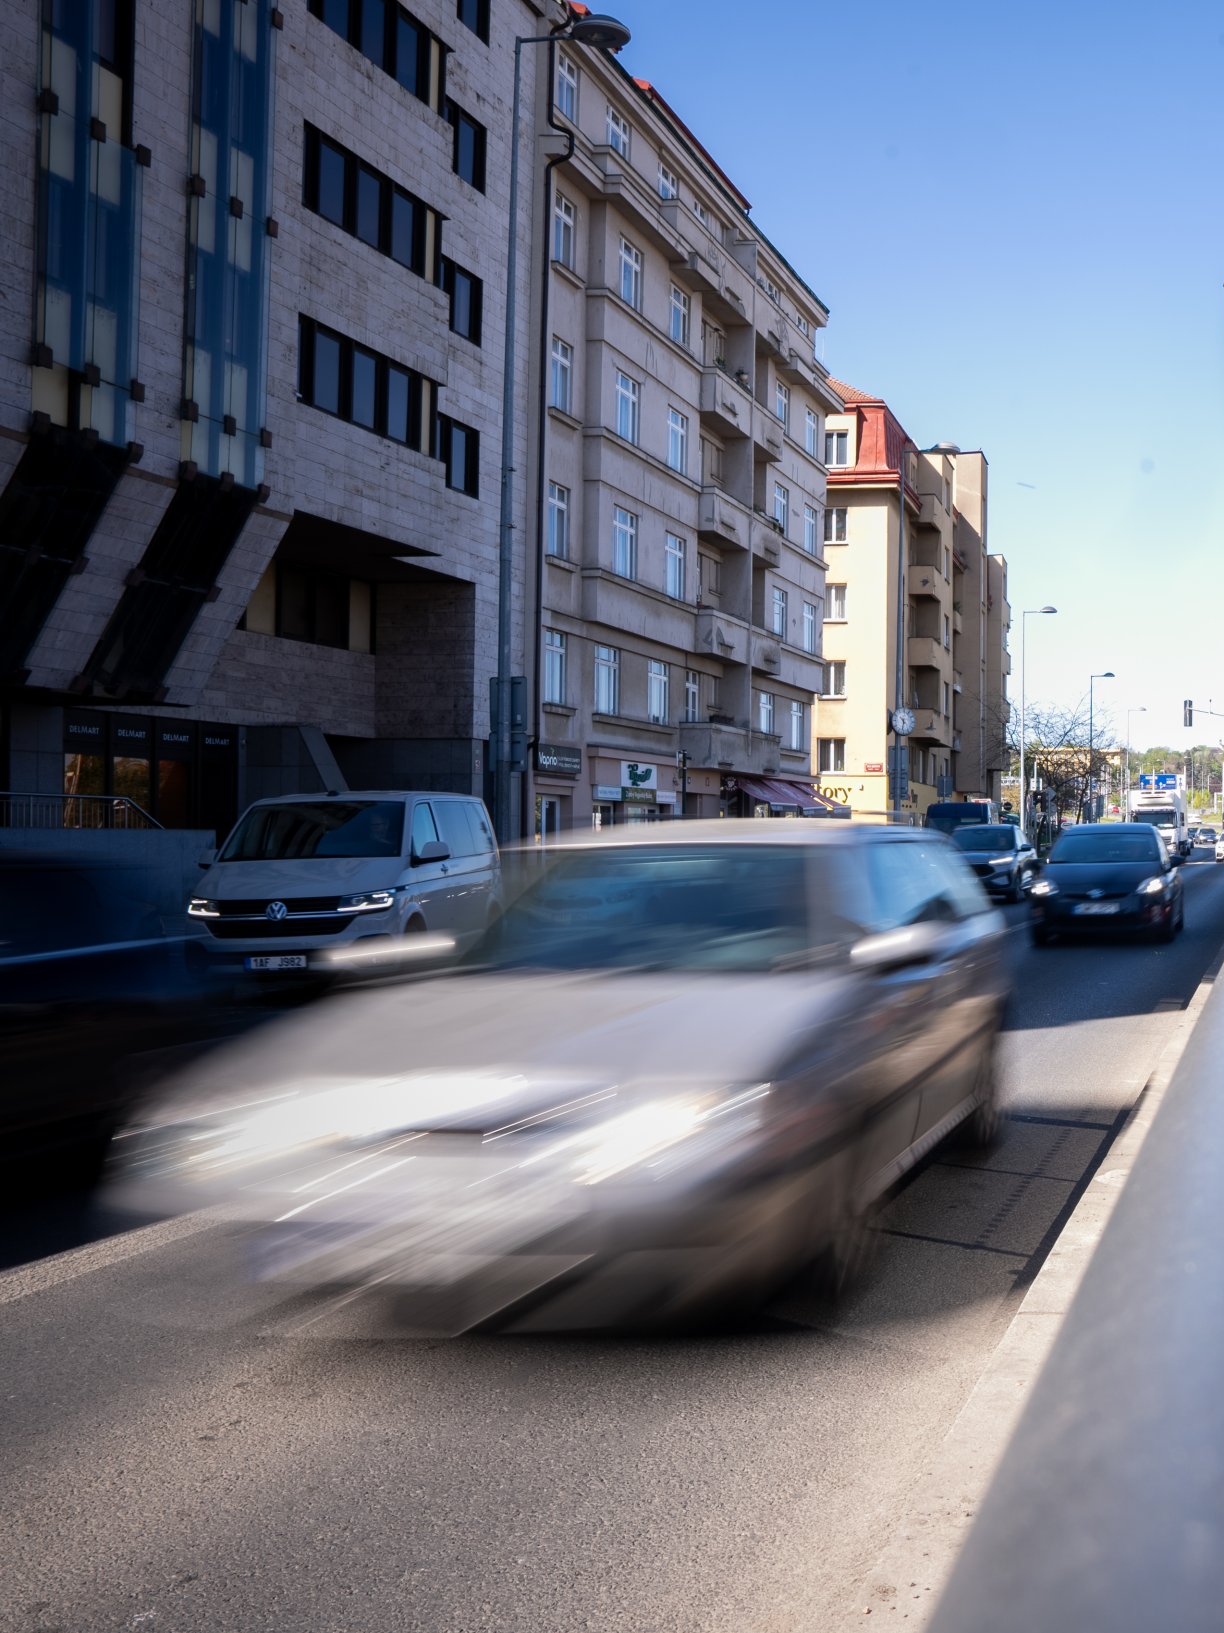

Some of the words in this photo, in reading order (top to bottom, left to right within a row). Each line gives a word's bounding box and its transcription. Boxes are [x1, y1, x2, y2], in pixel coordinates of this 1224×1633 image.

[69, 725, 100, 735] DELMART
[118, 729, 146, 739] DELMART
[163, 733, 190, 743] DELMART
[205, 737, 230, 746] DELMART
